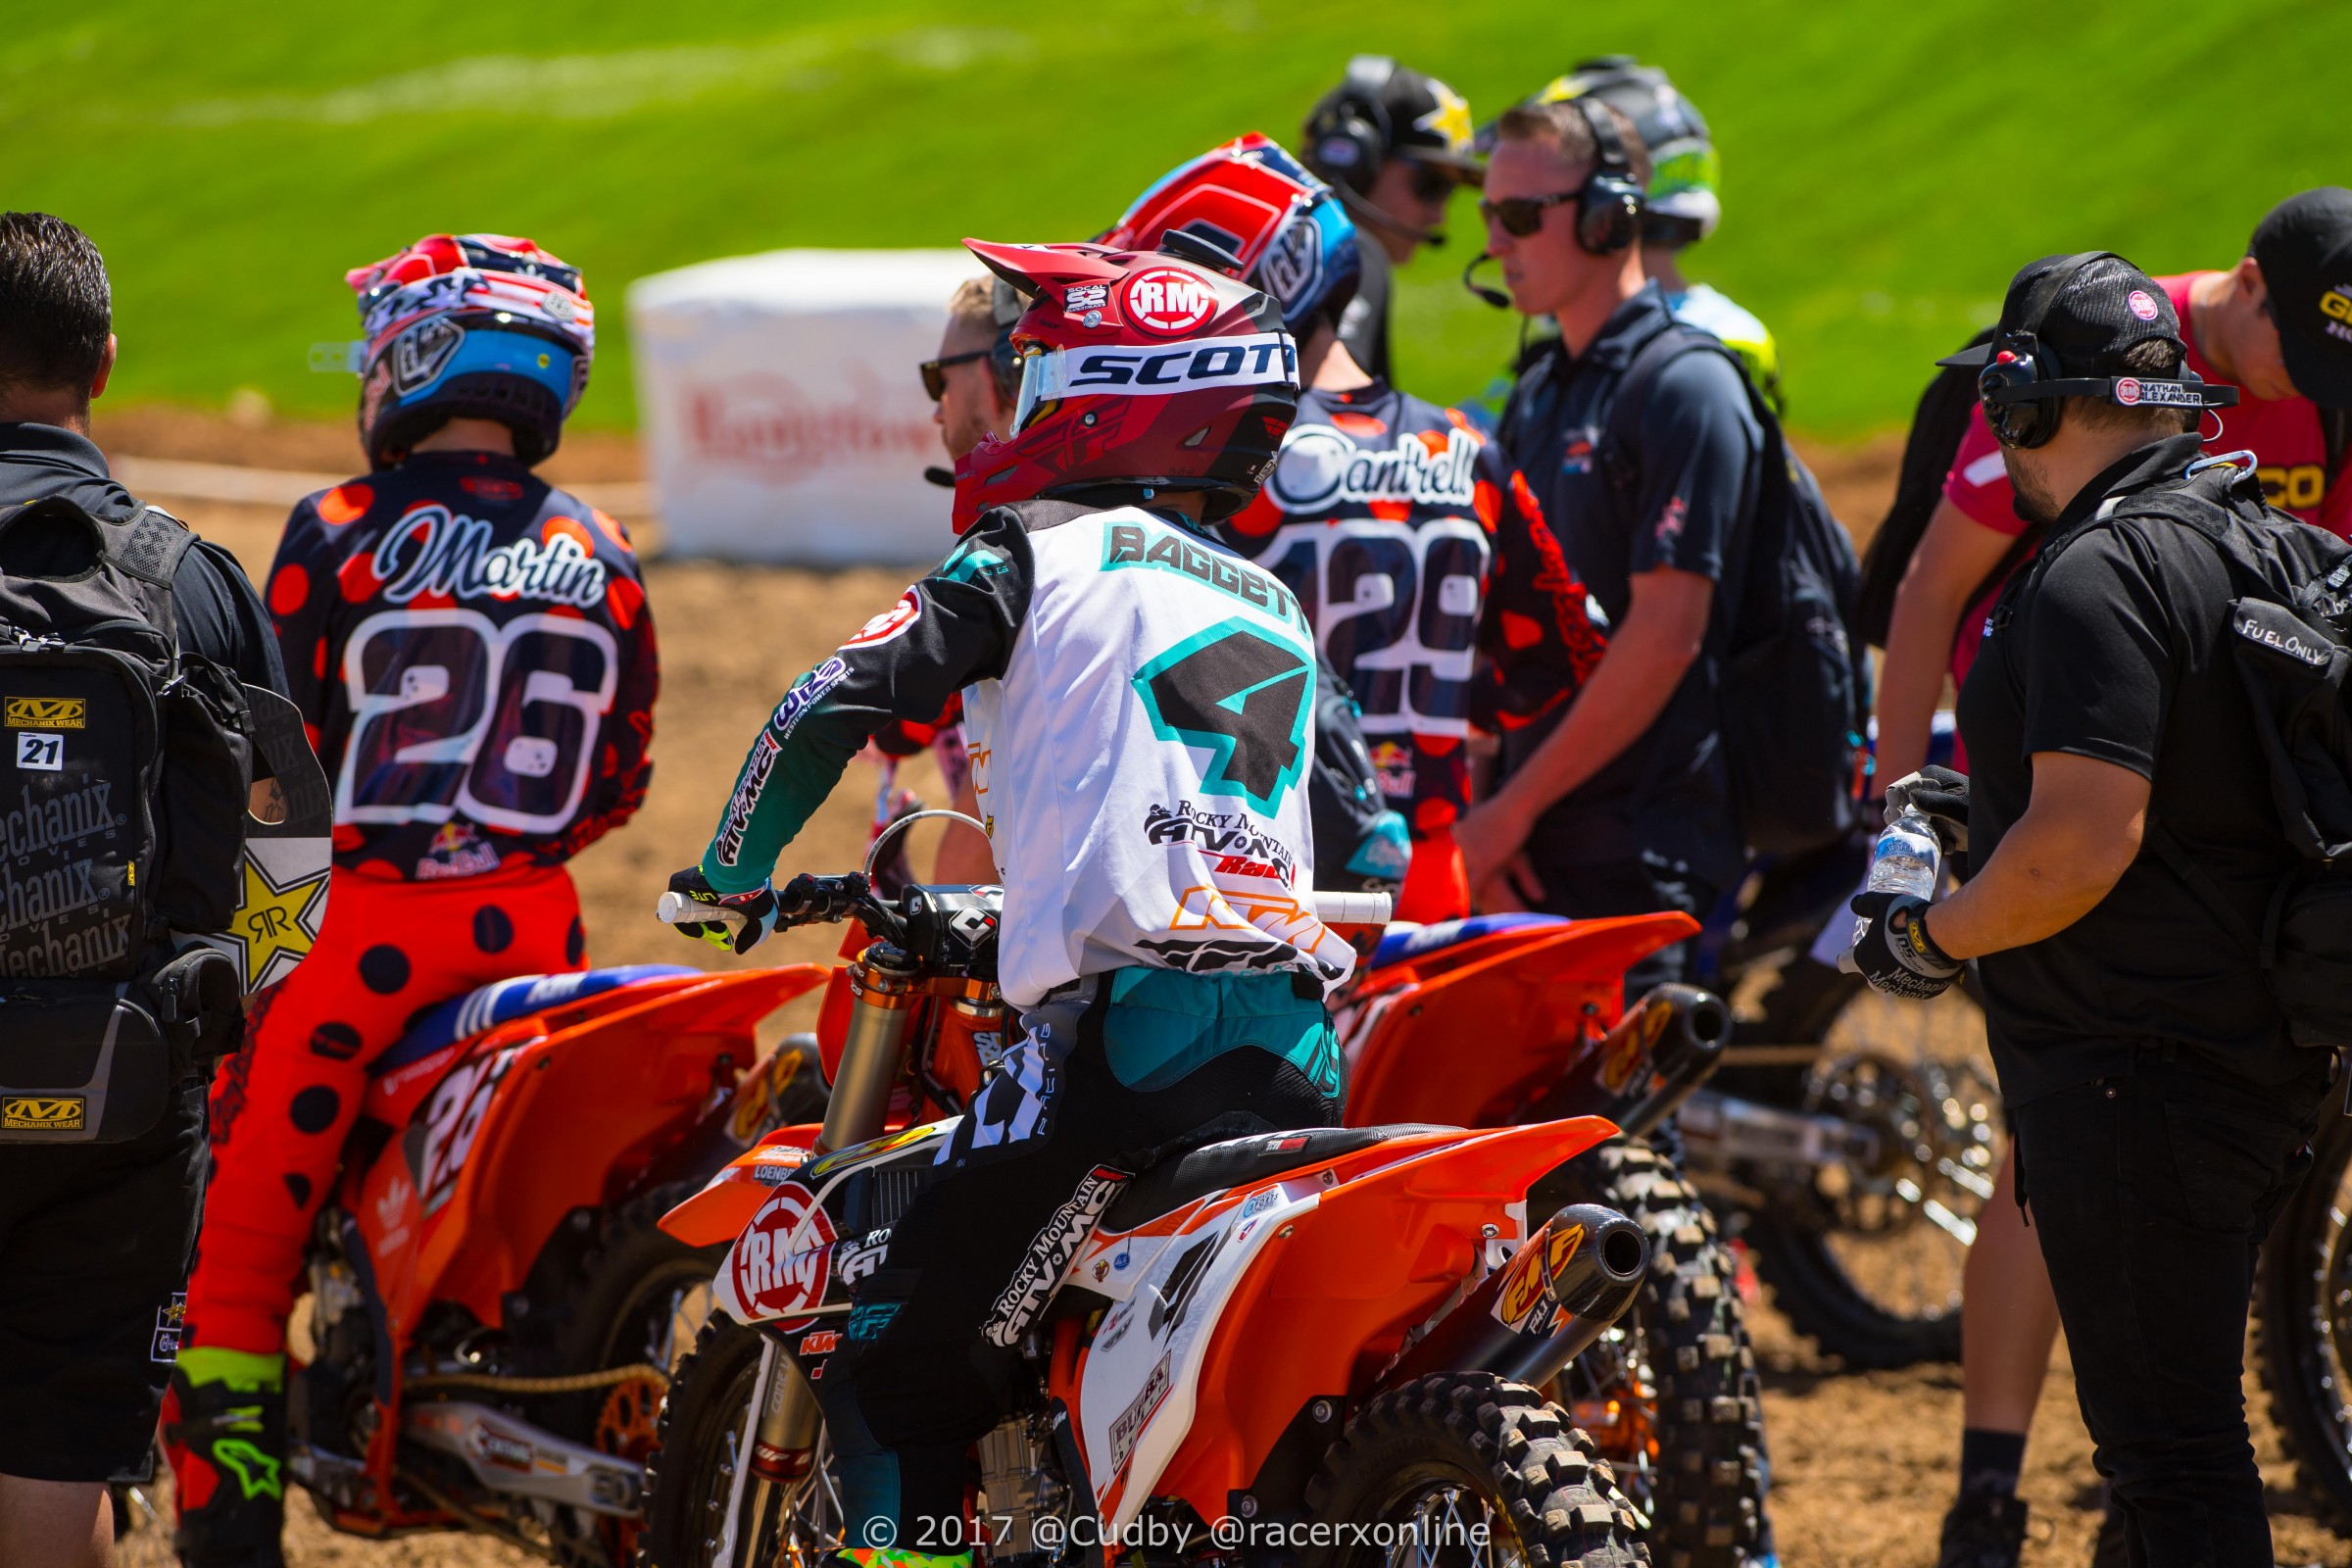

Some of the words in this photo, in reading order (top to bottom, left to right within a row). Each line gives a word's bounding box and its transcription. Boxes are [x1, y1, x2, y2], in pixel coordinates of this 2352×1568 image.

[1143, 282, 1198, 314] RM
[2137, 392, 2200, 404] ALEXANDER
[2140, 383, 2181, 393] NATHAN
[1270, 424, 1482, 514] Cantrell
[371, 504, 607, 609] Martin
[2242, 618, 2283, 648] FUEL
[2284, 635, 2324, 664] ONLY
[7, 716, 55, 726] MECHANIX
[56, 717, 83, 727] WEAR
[333, 608, 618, 833] 26
[784, 707, 808, 741] WESTERN
[808, 688, 832, 710] POWER
[830, 666, 856, 689] SPORTS
[1145, 627, 1311, 806] 4
[22, 739, 60, 765] 21
[4, 1118, 53, 1128] MECHANIX
[53, 1118, 81, 1129] WEAR
[997, 1258, 1041, 1318] ROCKY
[1033, 1176, 1100, 1261] MOUNTAIN
